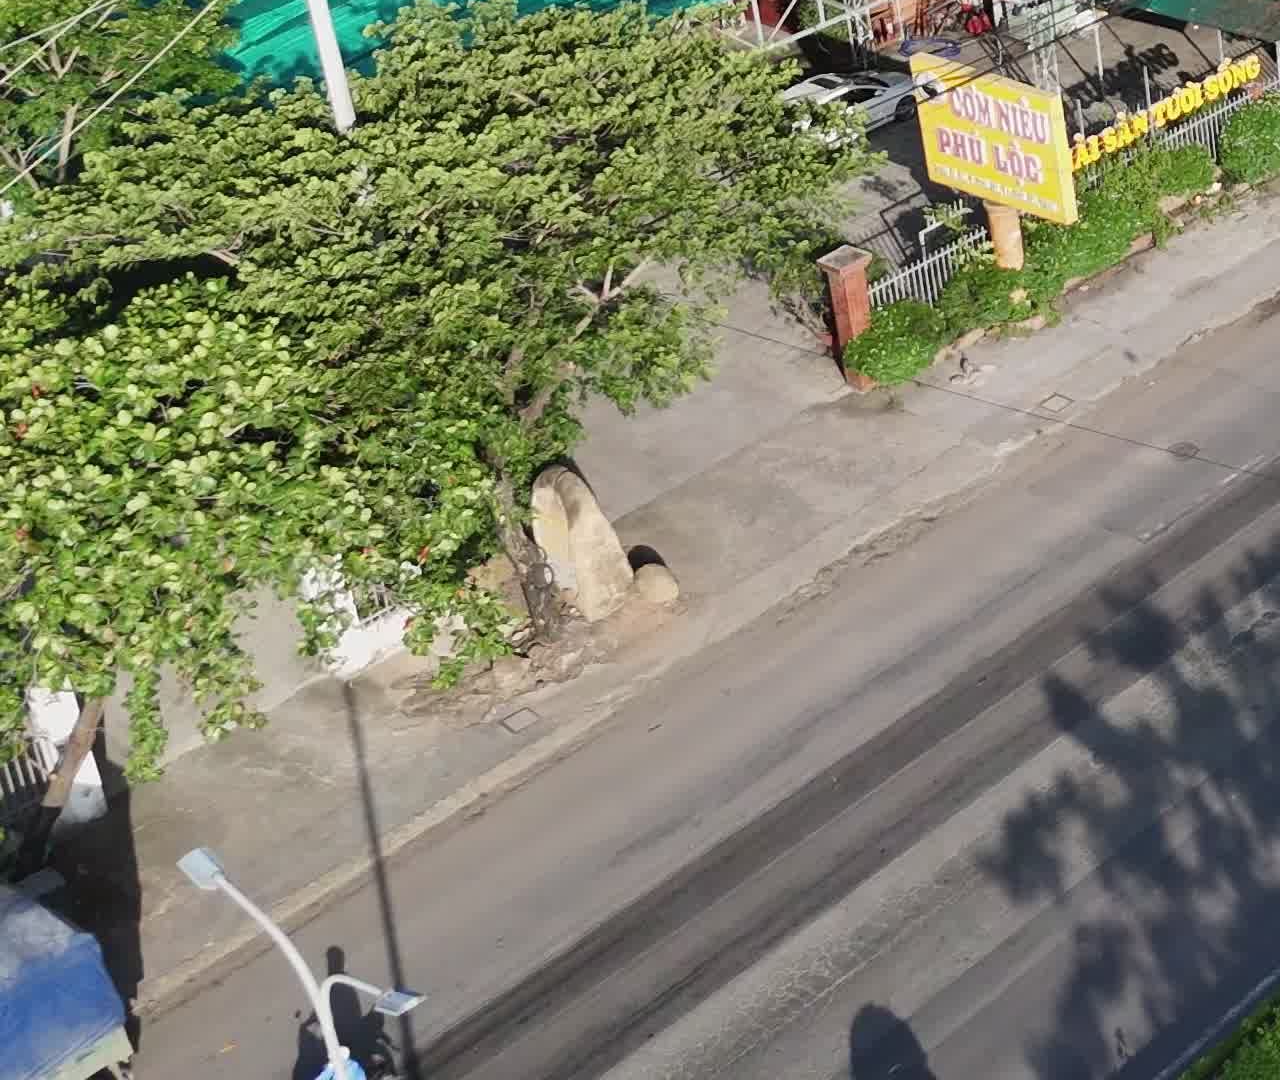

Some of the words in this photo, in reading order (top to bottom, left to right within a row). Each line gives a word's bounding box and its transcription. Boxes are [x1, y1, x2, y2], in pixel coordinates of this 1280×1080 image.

[1203, 55, 1261, 100] SỐNG
[950, 85, 994, 128] CƠM
[993, 140, 1043, 186] LỘC
